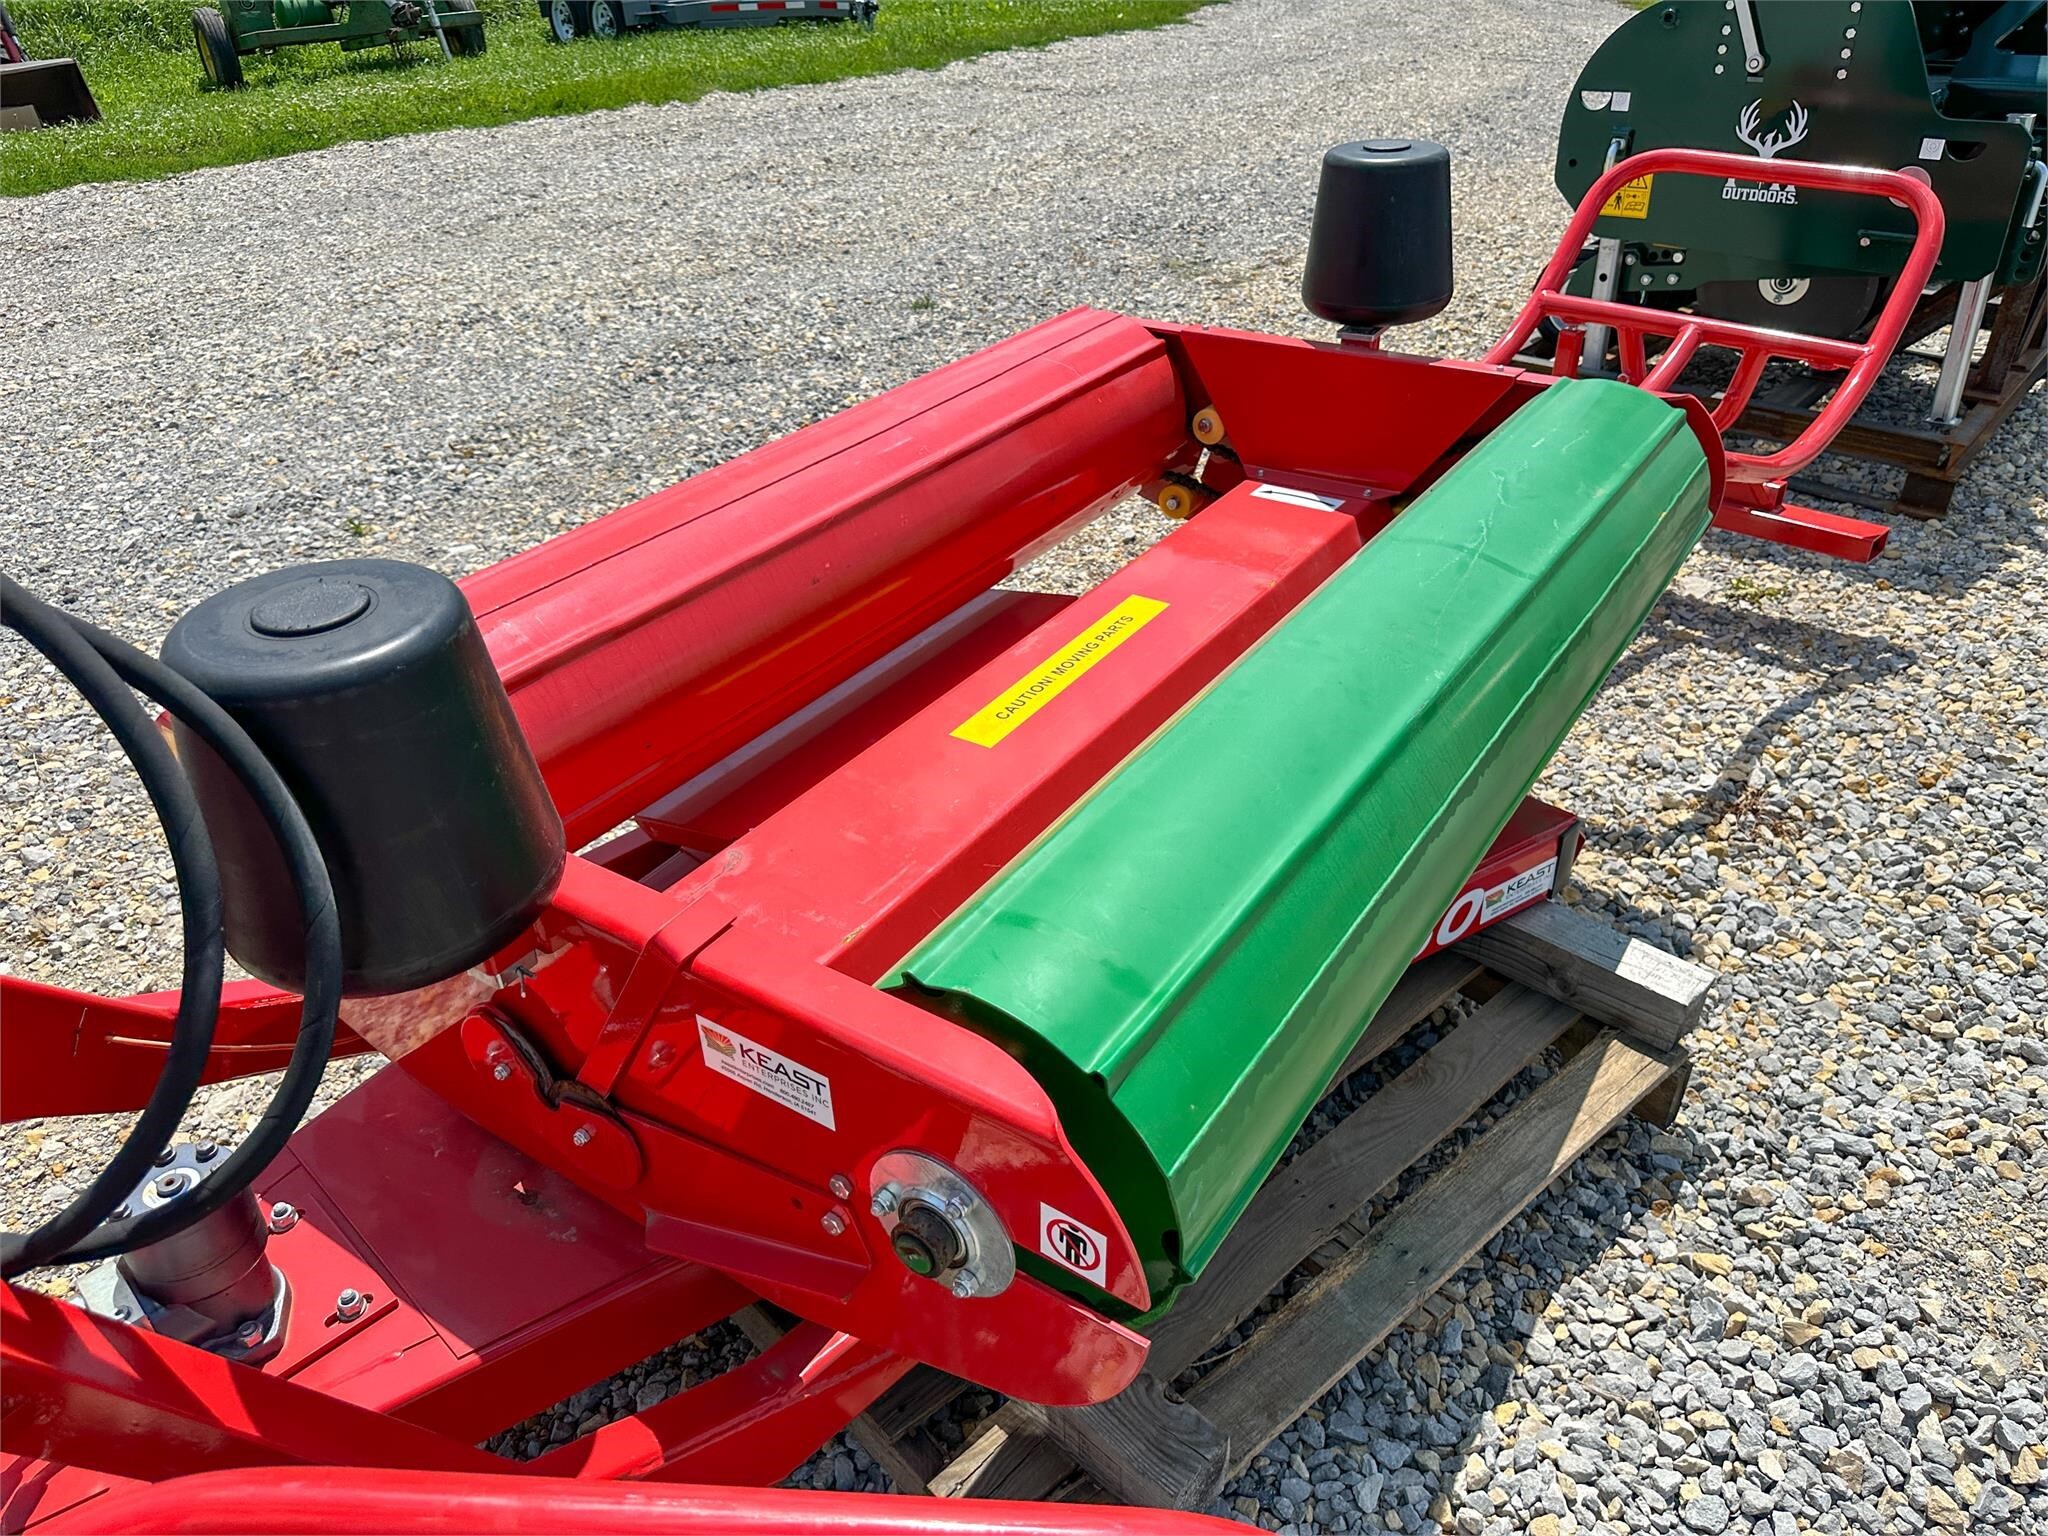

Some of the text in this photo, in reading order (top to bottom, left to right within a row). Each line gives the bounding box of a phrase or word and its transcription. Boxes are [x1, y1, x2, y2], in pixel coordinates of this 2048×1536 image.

[996, 615, 1134, 721] CAUTION! MOVING PARTS
[1506, 862, 1555, 893] KEAST
[739, 1043, 827, 1096] KEAST
[742, 1059, 809, 1098] ENTERPRISES
[811, 1093, 830, 1109] INC
